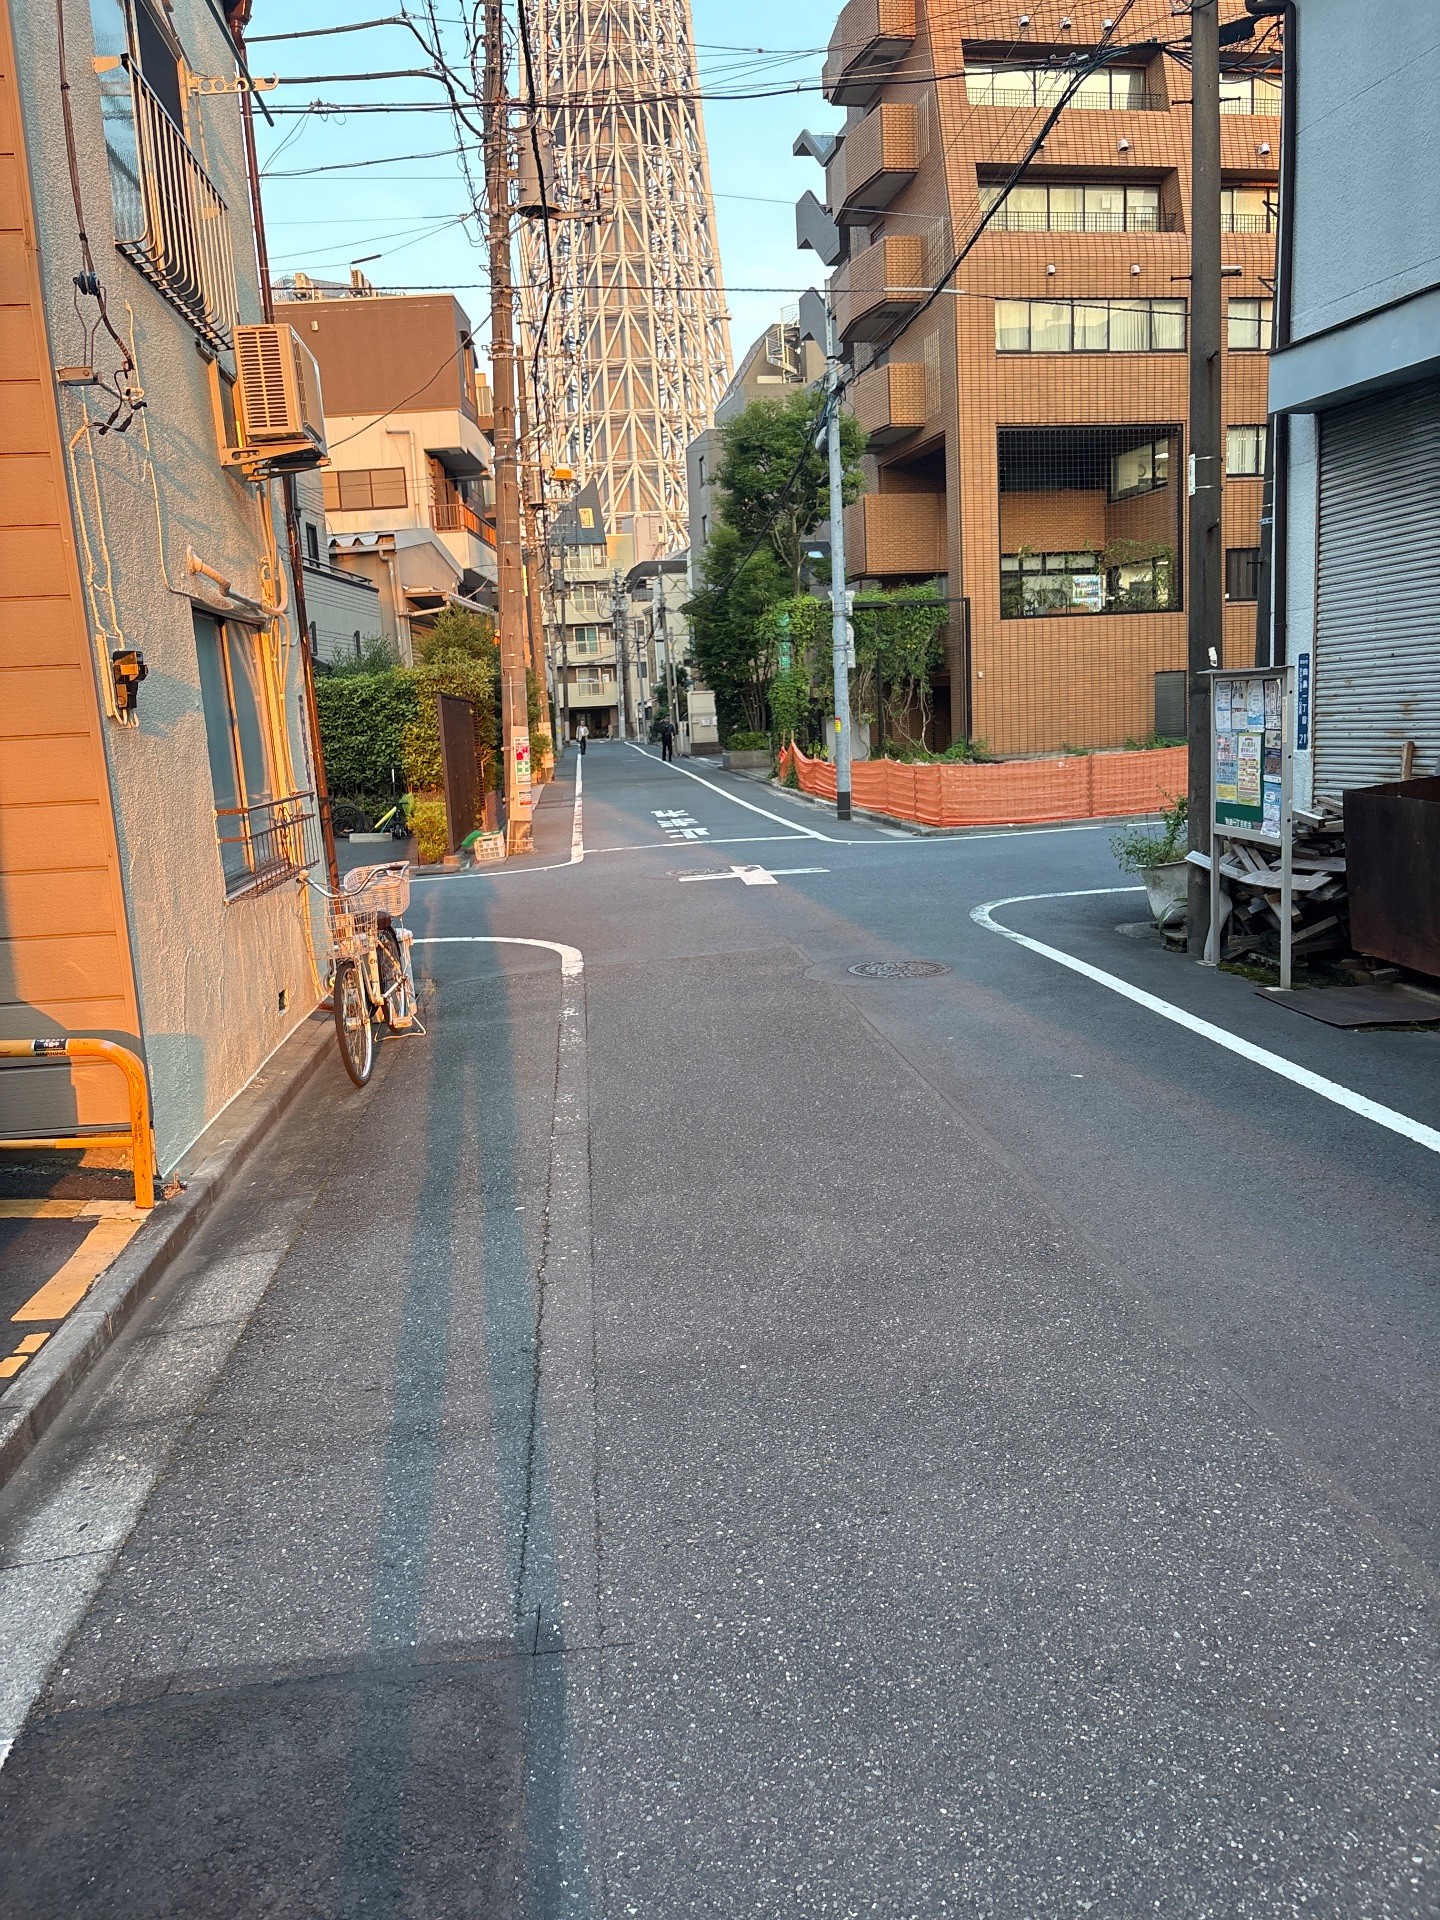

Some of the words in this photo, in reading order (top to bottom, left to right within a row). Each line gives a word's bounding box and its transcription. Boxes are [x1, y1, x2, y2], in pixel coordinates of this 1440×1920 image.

[1299, 733, 1307, 744] 21
[650, 809, 710, 839] 止まれ
